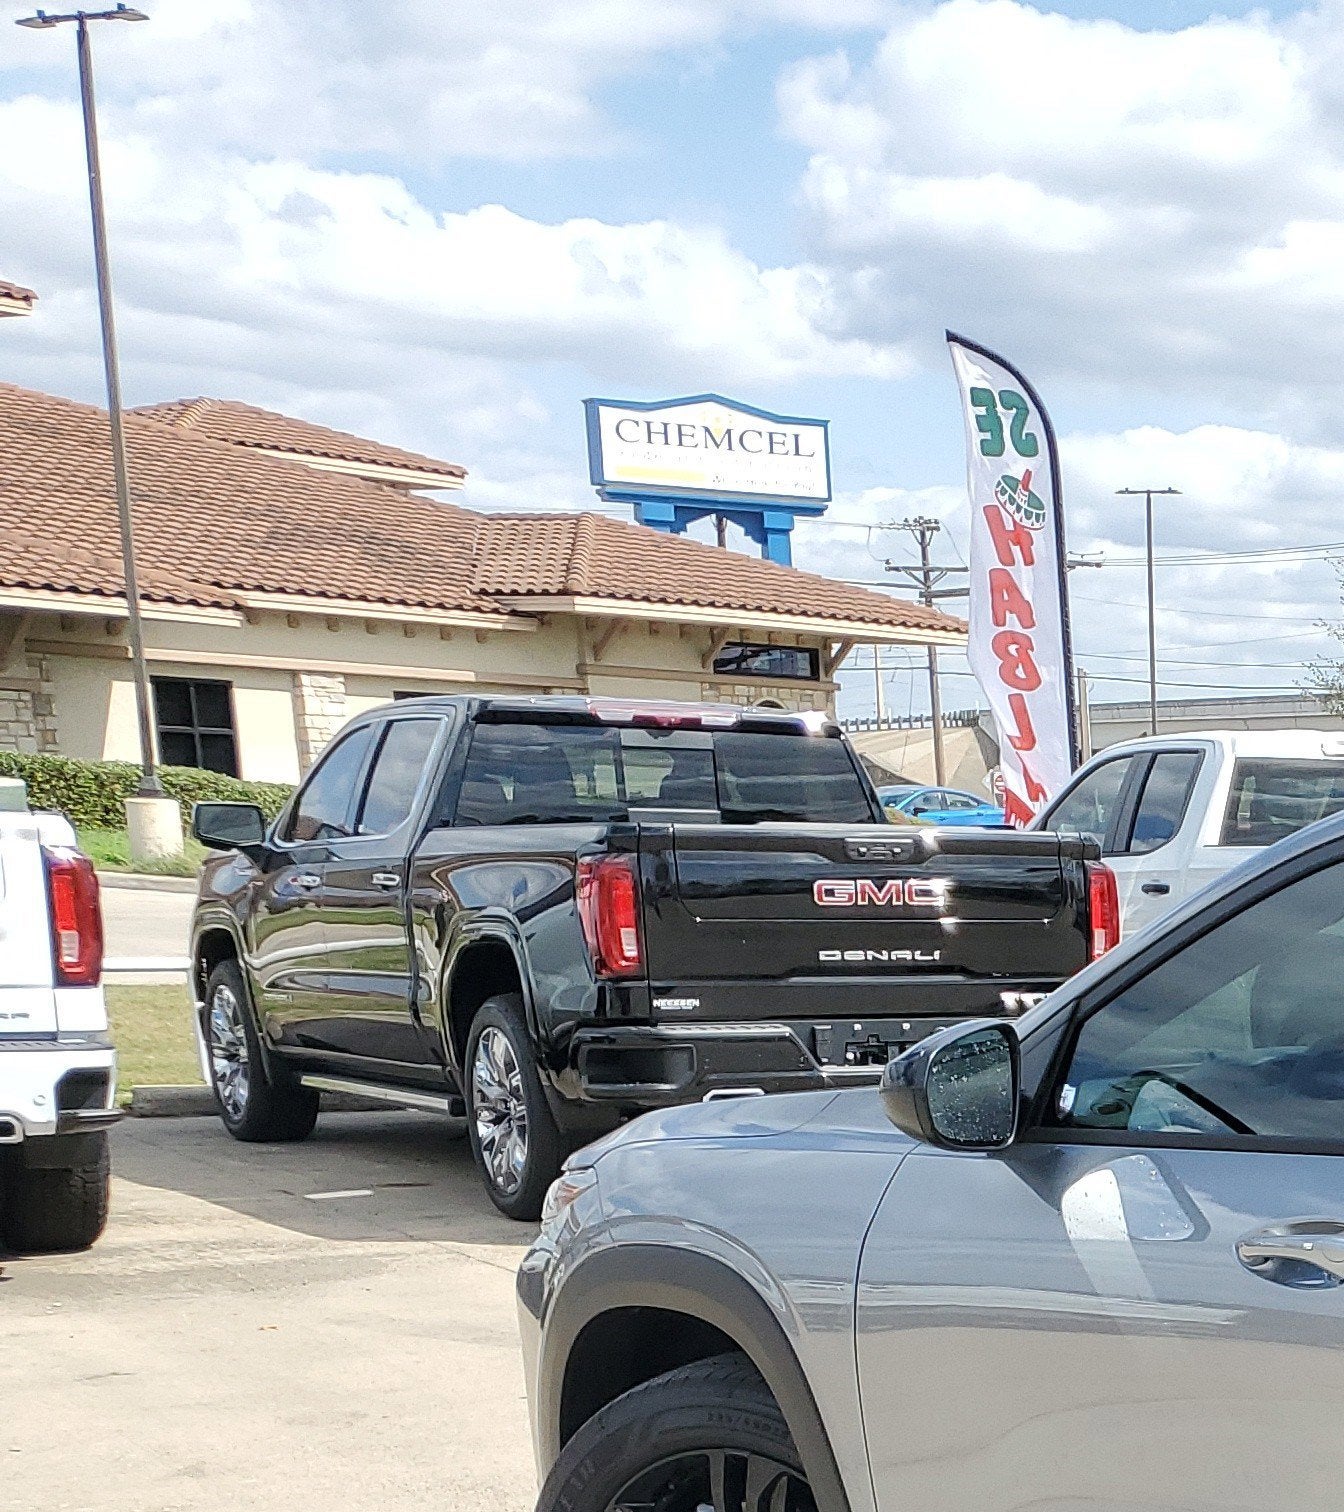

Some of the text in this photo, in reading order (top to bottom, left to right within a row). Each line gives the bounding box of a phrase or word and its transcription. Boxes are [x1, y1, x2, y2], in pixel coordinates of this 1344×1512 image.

[615, 418, 816, 458] CHEMCEL
[814, 879, 946, 906] GMC
[818, 949, 942, 961] DENALI
